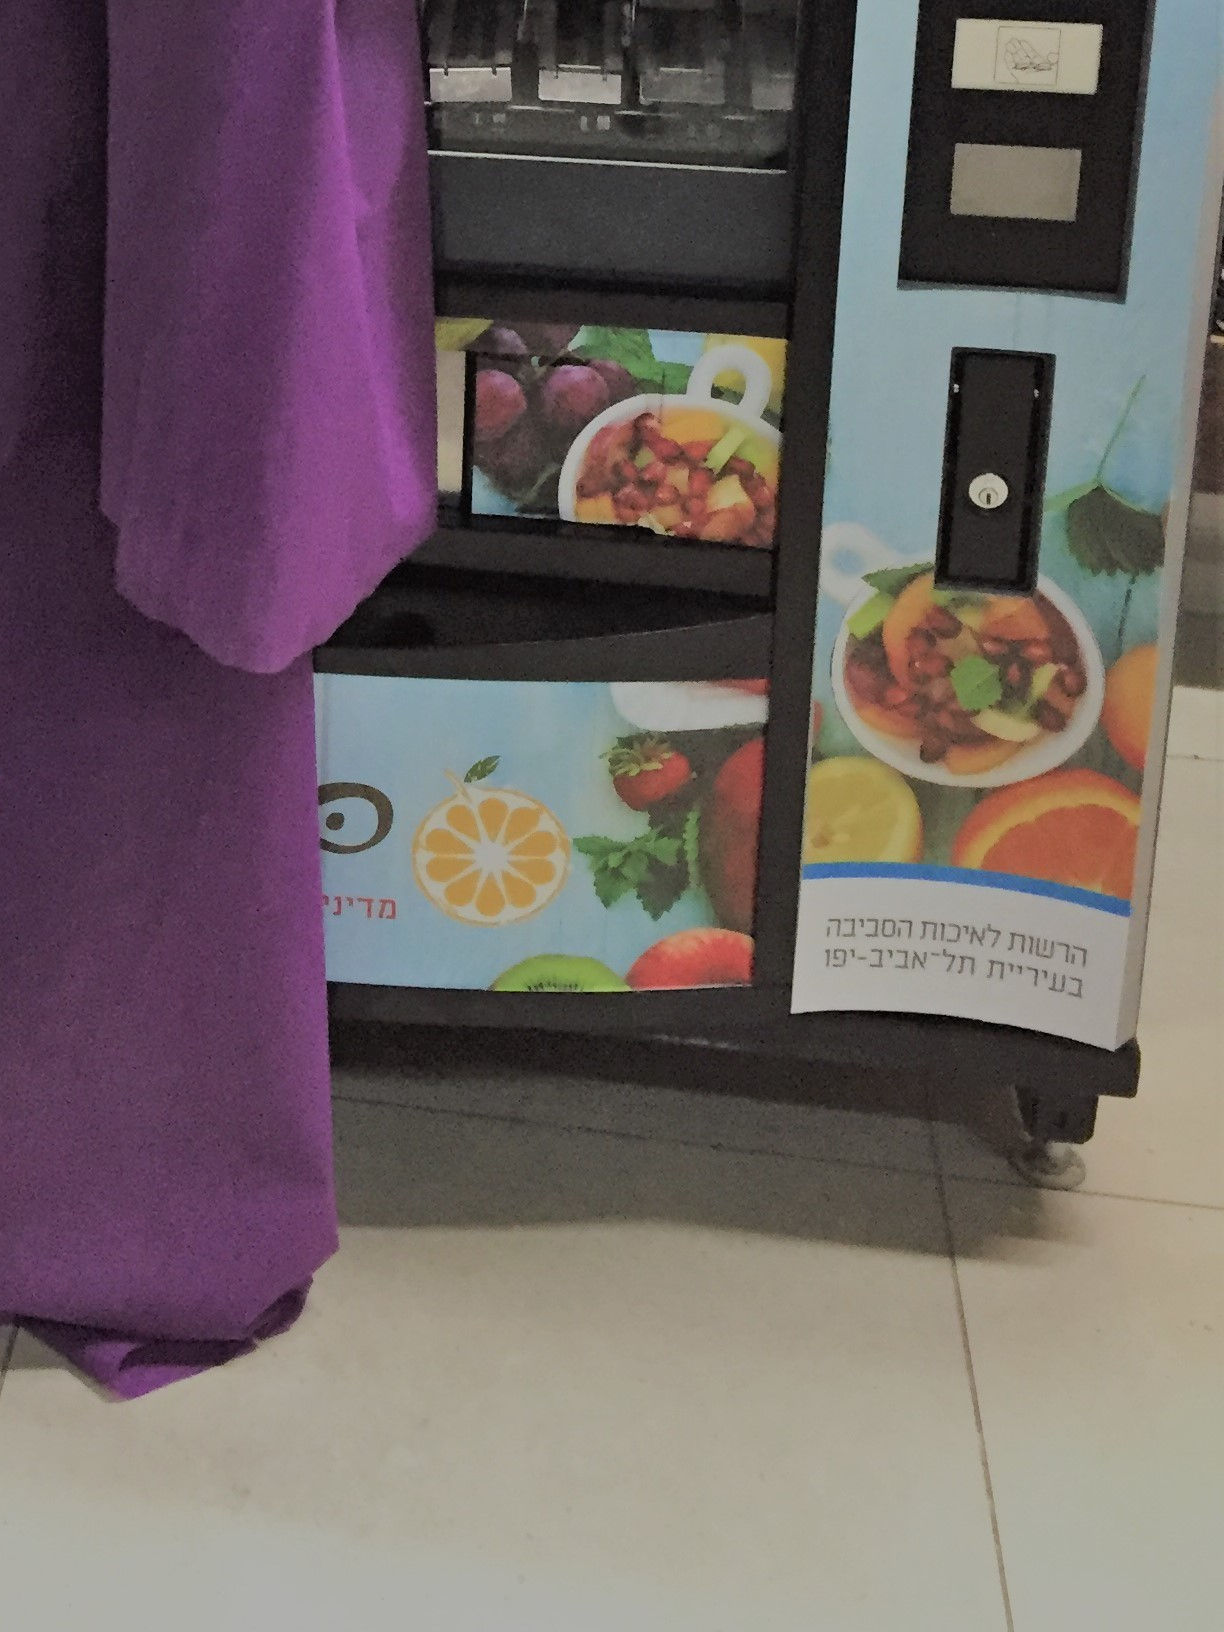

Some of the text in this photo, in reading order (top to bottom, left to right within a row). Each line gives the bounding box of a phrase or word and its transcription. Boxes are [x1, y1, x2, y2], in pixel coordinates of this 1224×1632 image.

[825, 917, 1089, 968] הרשות לאיכות הסביבה
[985, 957, 1084, 999] בעיריית
